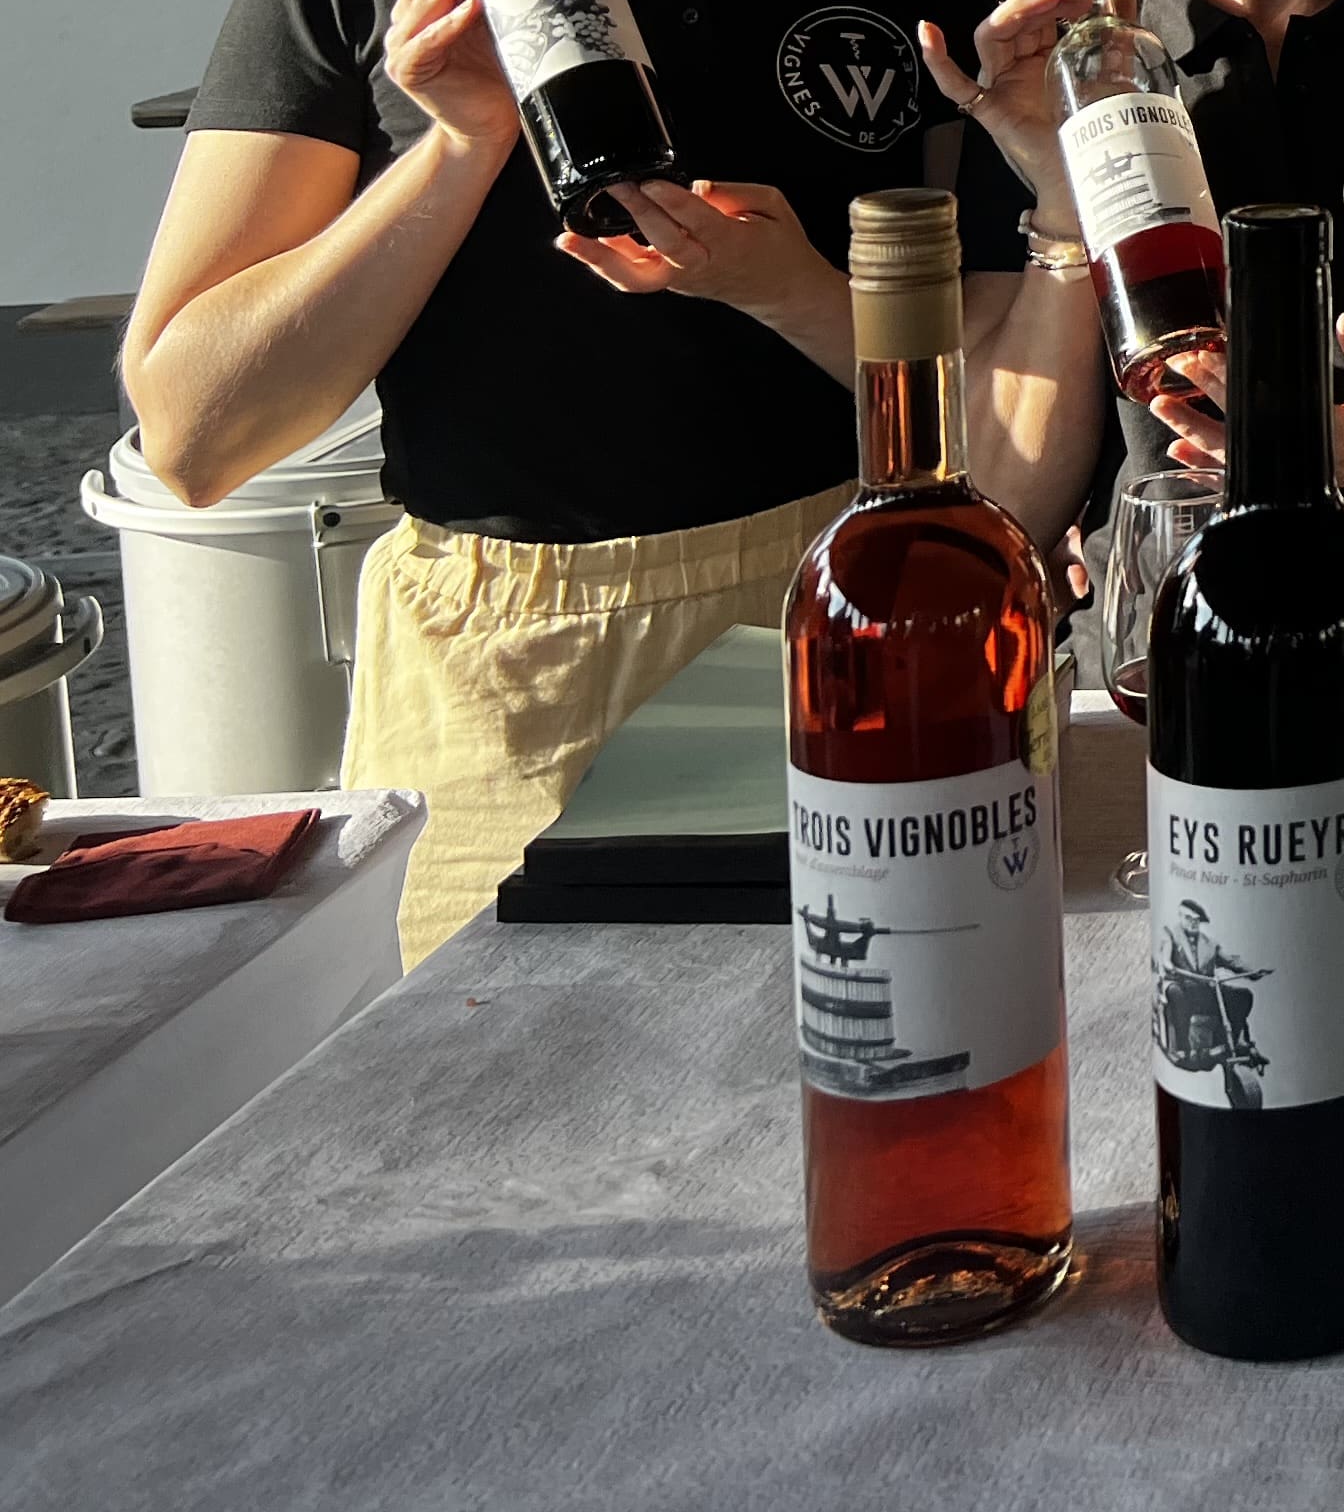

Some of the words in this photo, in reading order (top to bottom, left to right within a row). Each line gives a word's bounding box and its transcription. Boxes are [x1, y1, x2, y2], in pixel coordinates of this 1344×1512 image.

[783, 33, 821, 117] VIGNES
[858, 131, 876, 144] DE
[1072, 112, 1114, 149] TROIS
[793, 800, 851, 857] TROIS
[864, 785, 1037, 858] VIGNOBLES
[1169, 814, 1220, 864] EYS
[1169, 860, 1197, 881] Pinot
[1199, 869, 1228, 886] Noir
[1242, 866, 1328, 889] St-Saphorin
